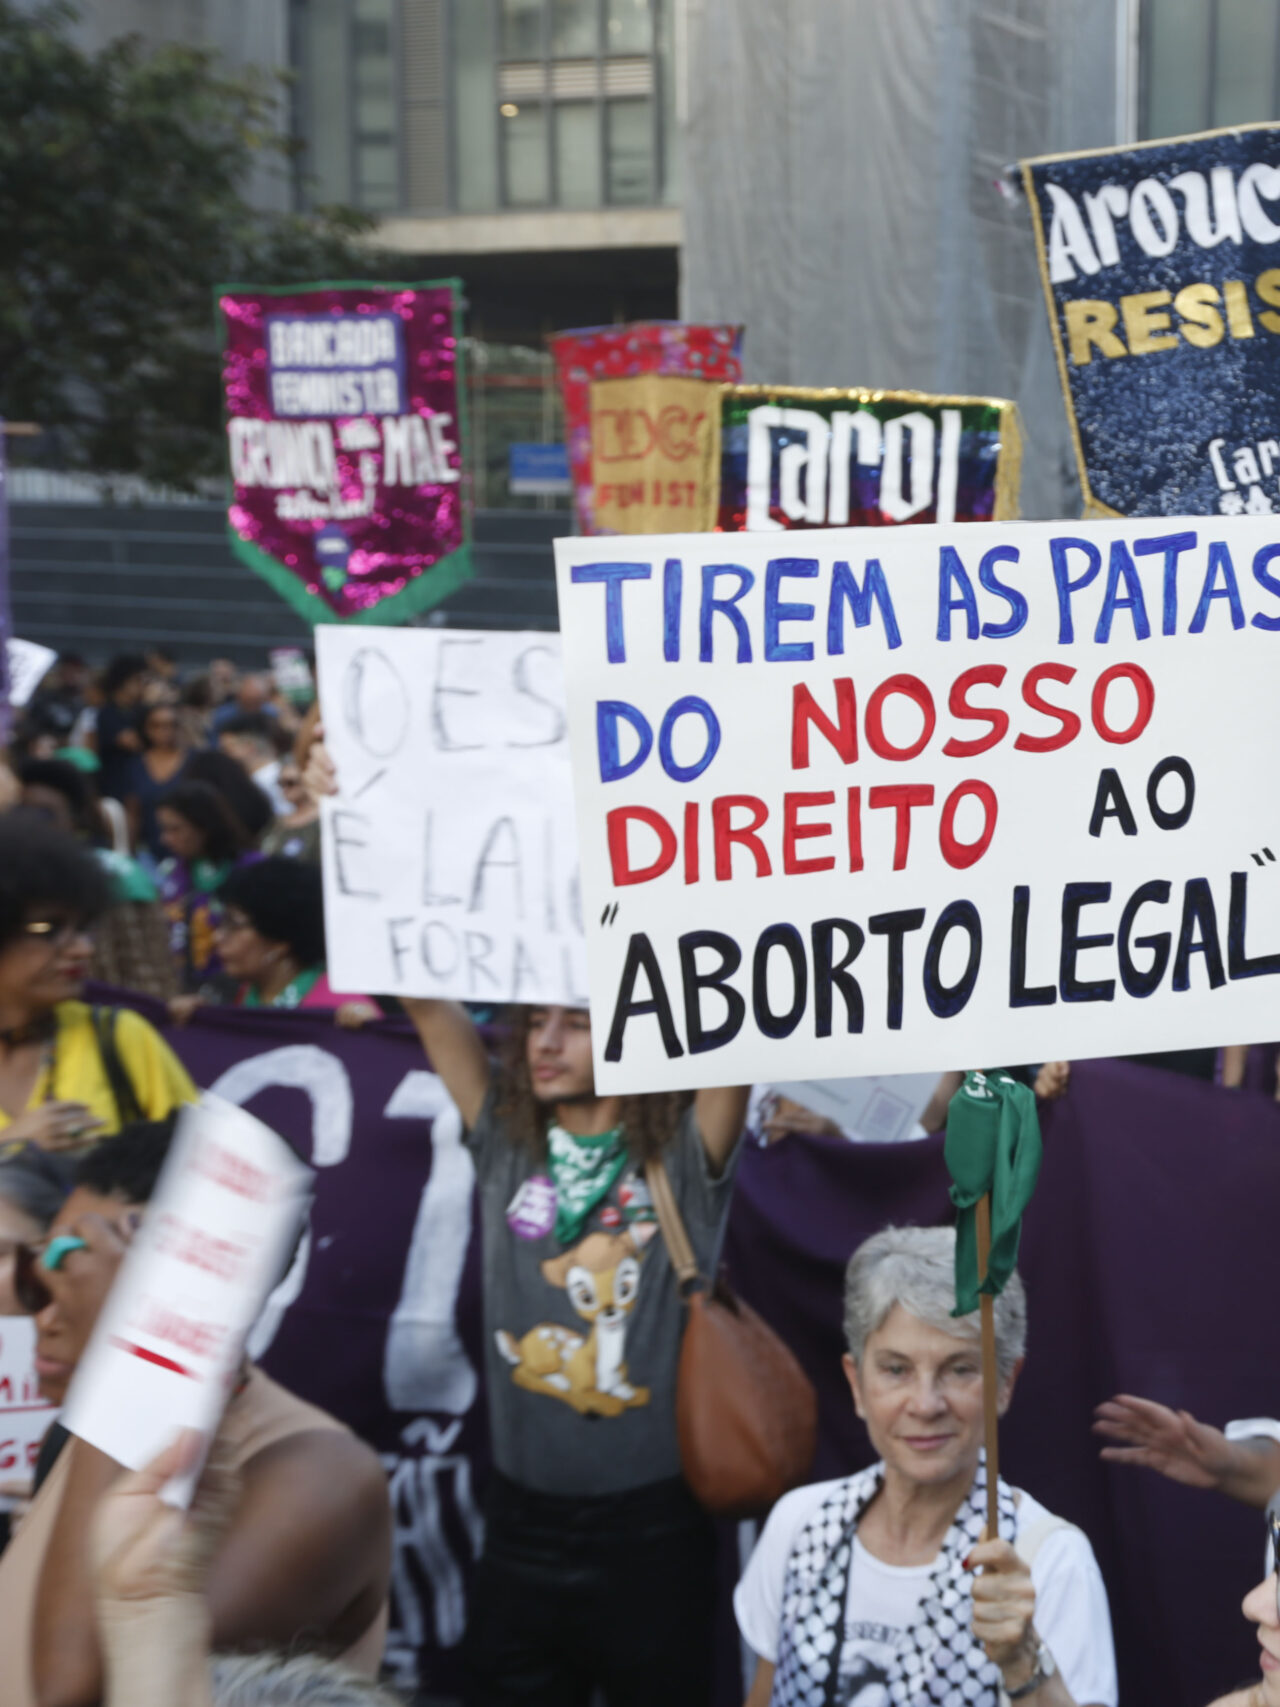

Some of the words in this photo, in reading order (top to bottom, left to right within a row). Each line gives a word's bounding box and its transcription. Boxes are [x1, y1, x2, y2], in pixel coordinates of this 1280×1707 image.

[747, 405, 962, 531] Carol
[571, 558, 902, 663] TIREM
[937, 545, 1028, 641] AS
[597, 695, 721, 783] DO
[791, 662, 1155, 769] NOSSO
[606, 779, 998, 886] DIREITO
[1089, 756, 1195, 837] AO
